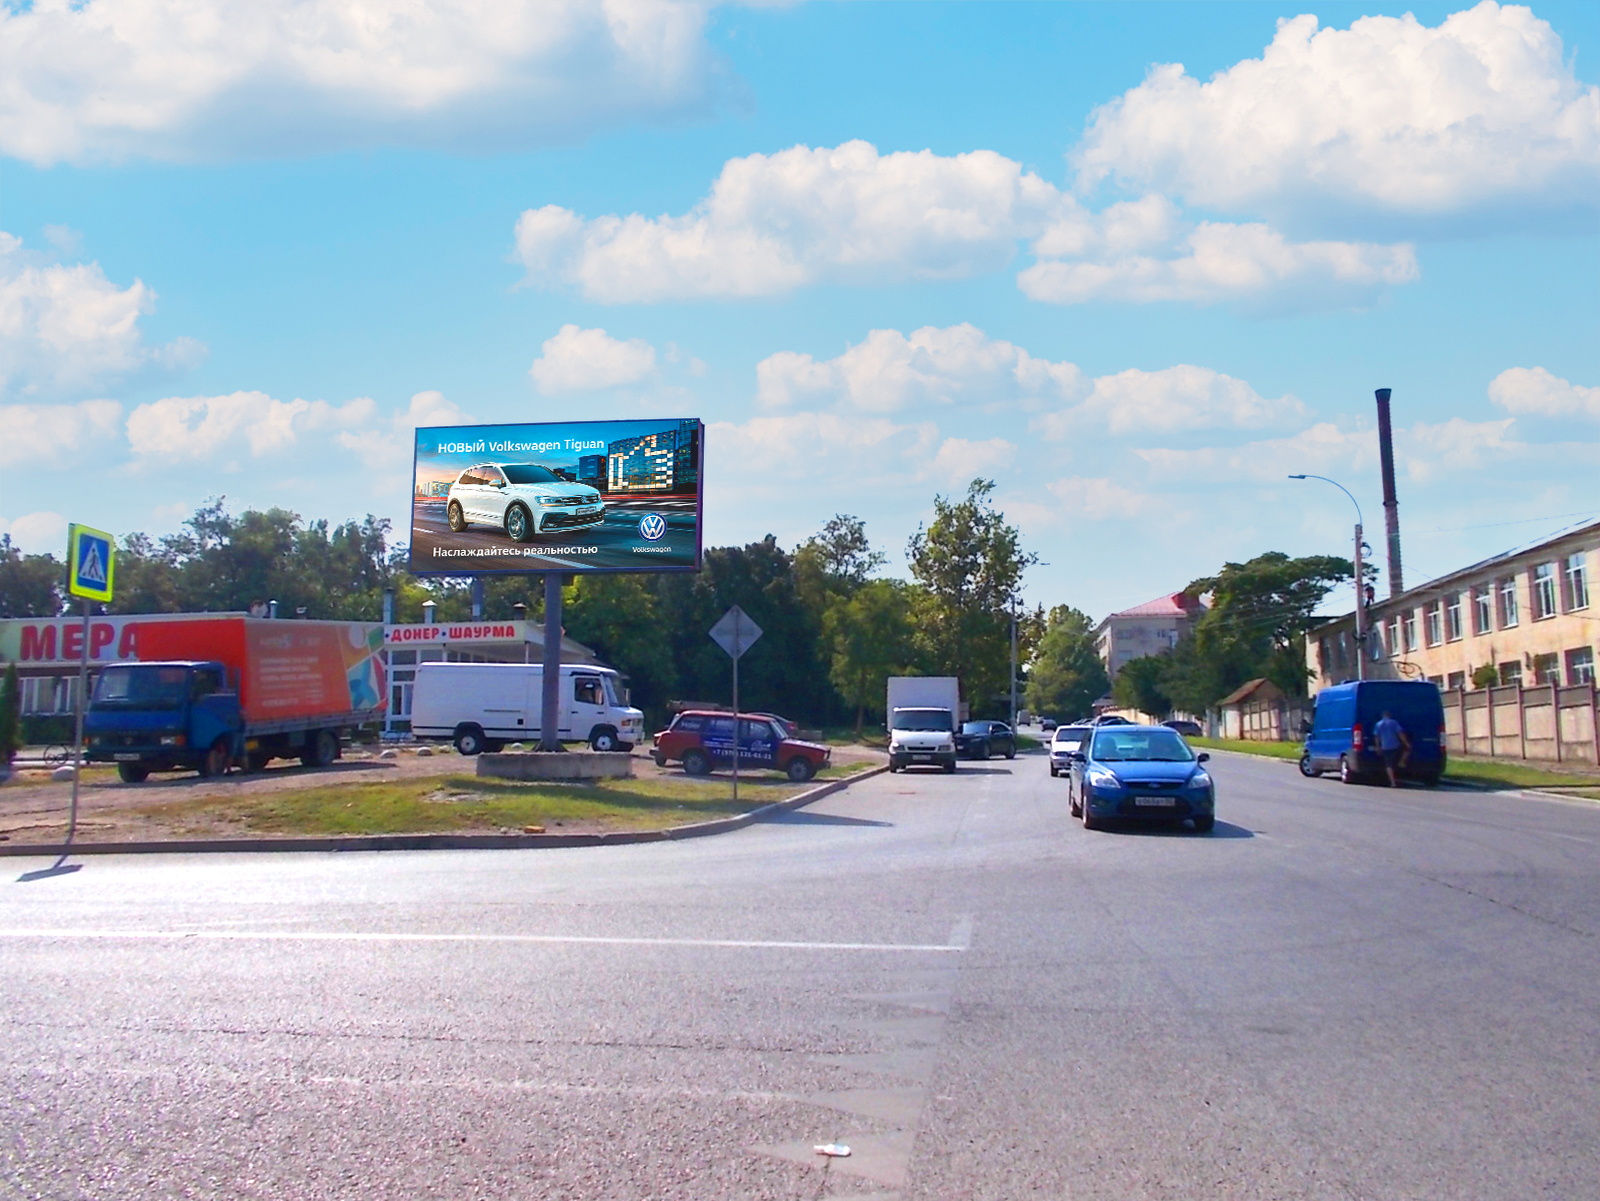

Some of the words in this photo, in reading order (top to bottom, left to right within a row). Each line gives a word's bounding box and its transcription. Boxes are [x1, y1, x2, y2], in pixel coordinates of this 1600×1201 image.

[438, 439, 485, 454] НОВЫЙ
[488, 440, 561, 455] Volkswagen
[564, 439, 605, 453] Tiguan
[433, 546, 521, 558] Наслаждайтесь
[523, 544, 598, 557] реальностью
[632, 545, 672, 555] Volkswagen
[390, 626, 439, 642] ДОНЕР
[449, 625, 515, 639] ШАУРМА
